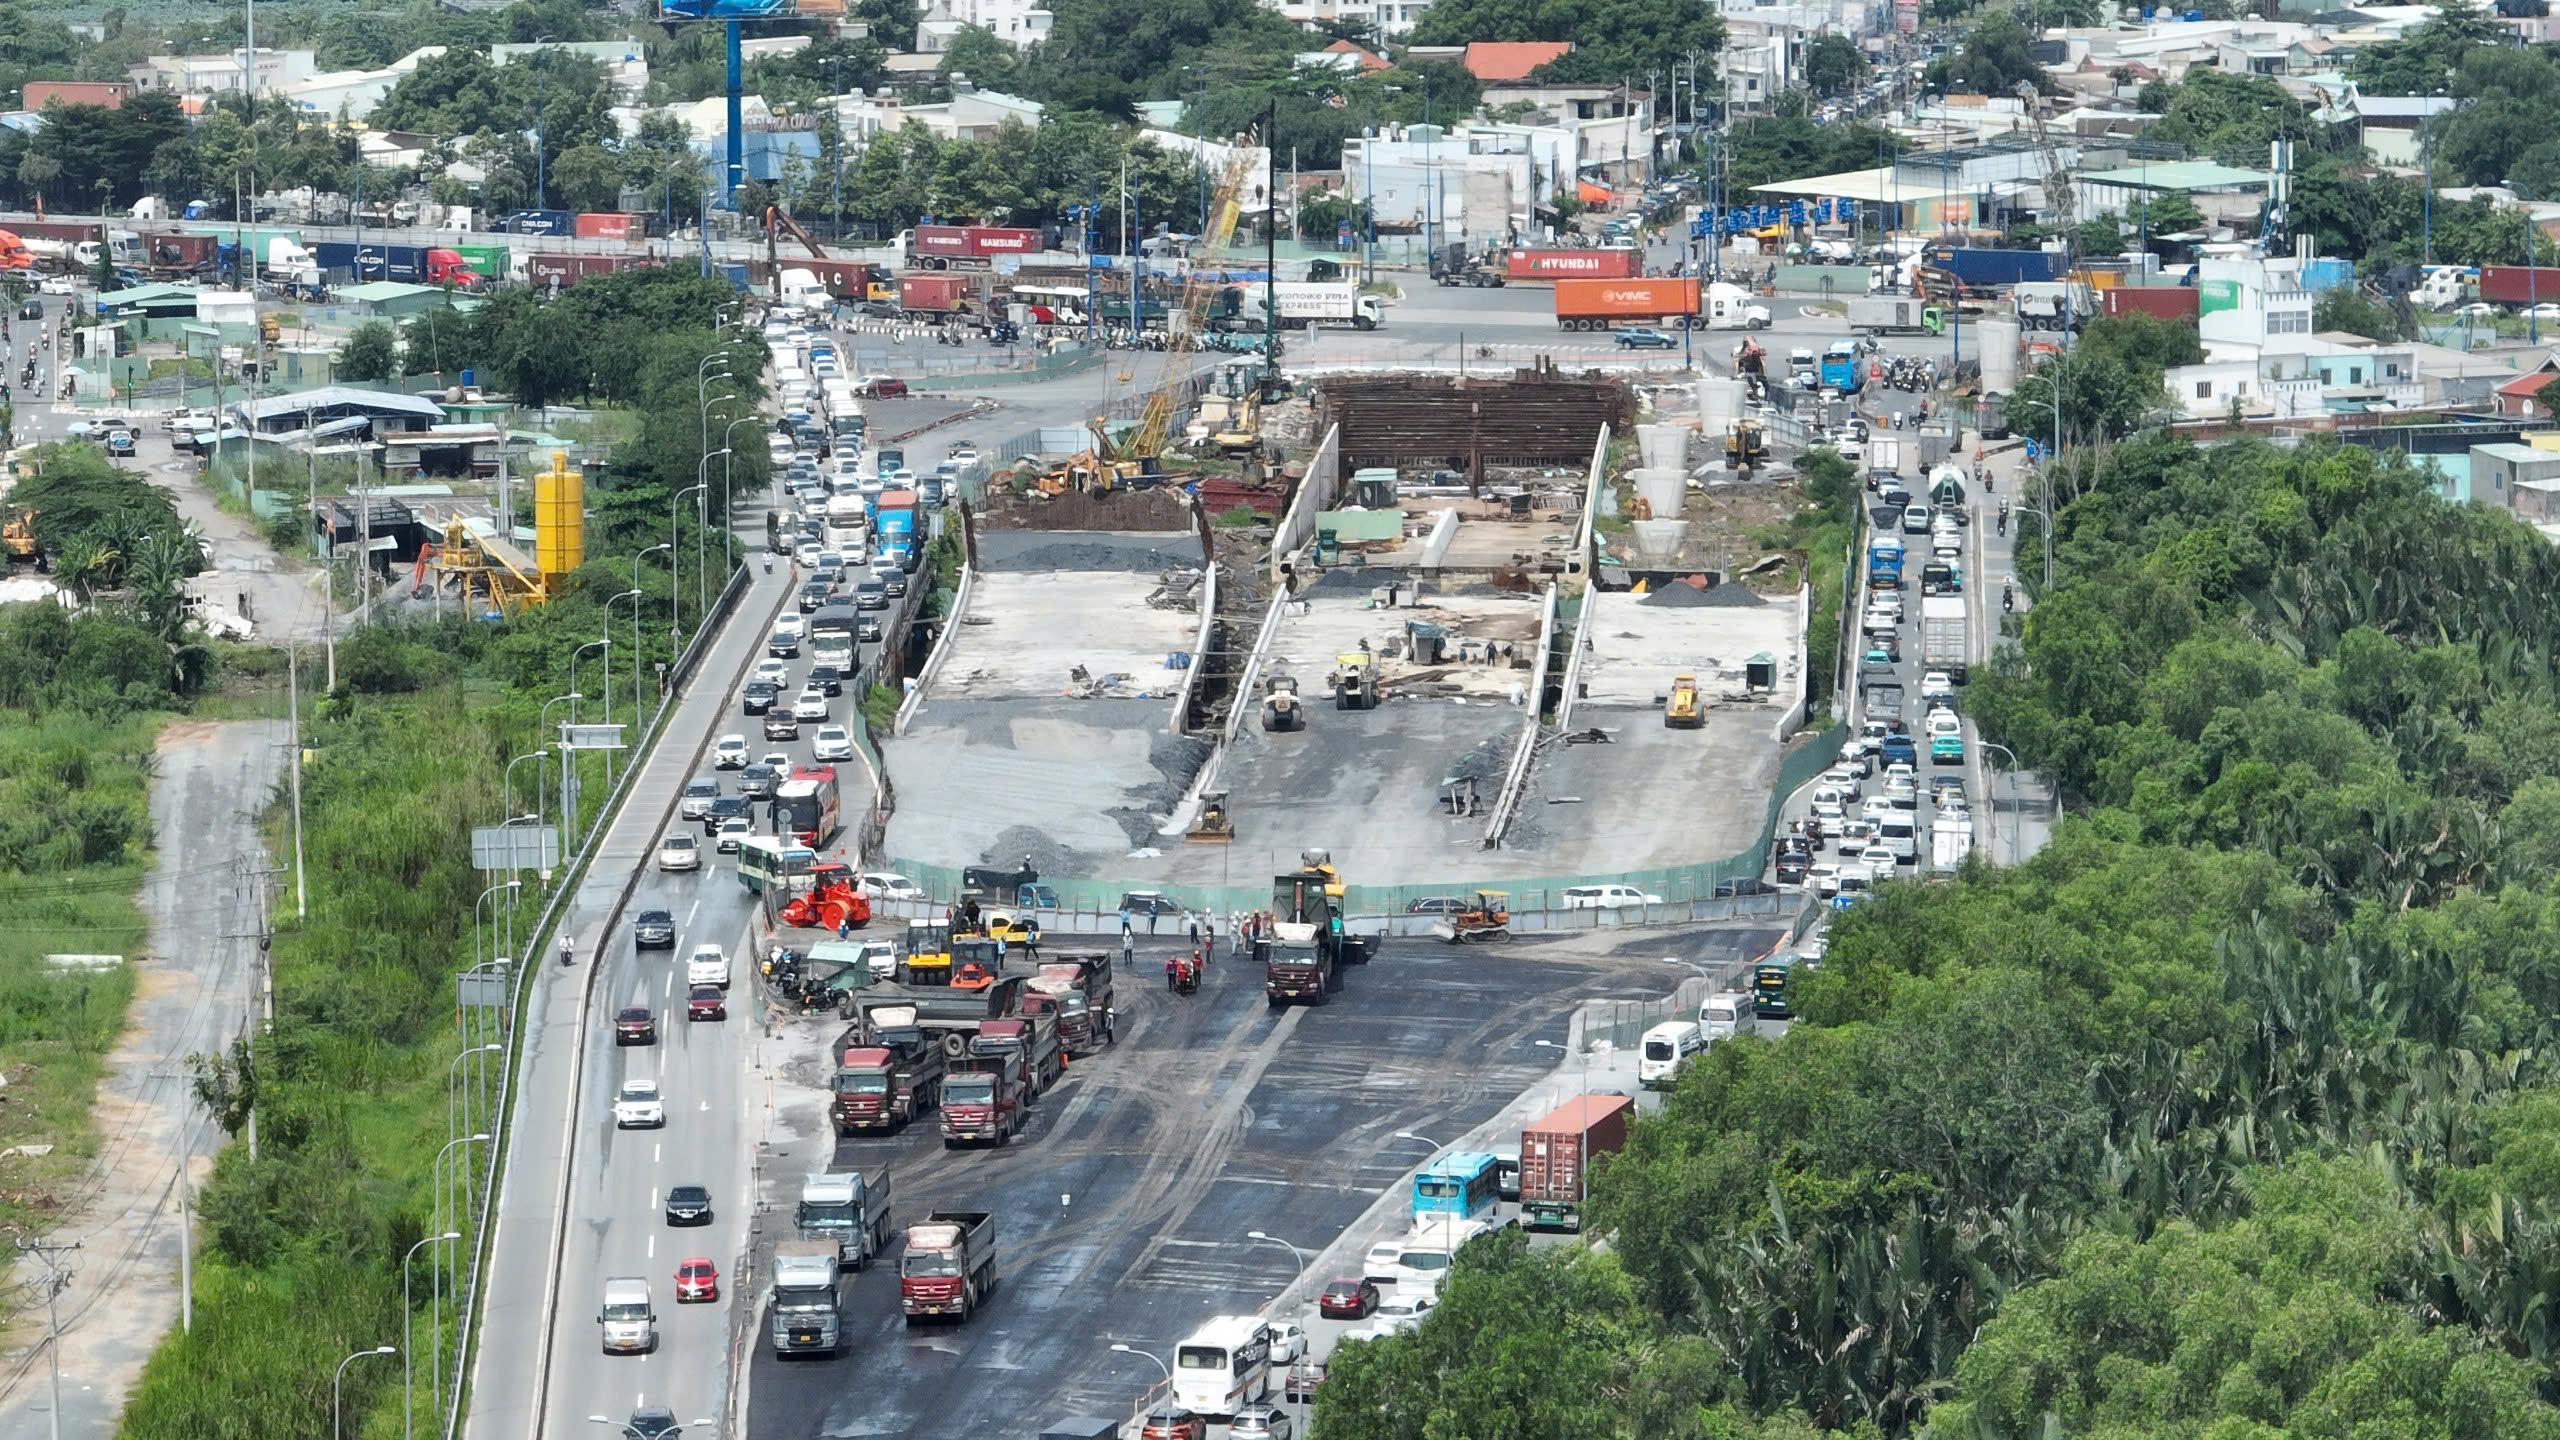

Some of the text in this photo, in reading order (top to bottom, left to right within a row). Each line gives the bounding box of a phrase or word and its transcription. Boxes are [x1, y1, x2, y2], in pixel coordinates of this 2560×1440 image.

[980, 238, 1022, 248] NAMSUNG
[1541, 258, 1599, 269] HYUNDAI
[1615, 291, 1651, 301] VIMC
[1280, 302, 1322, 310] EXPRESS
